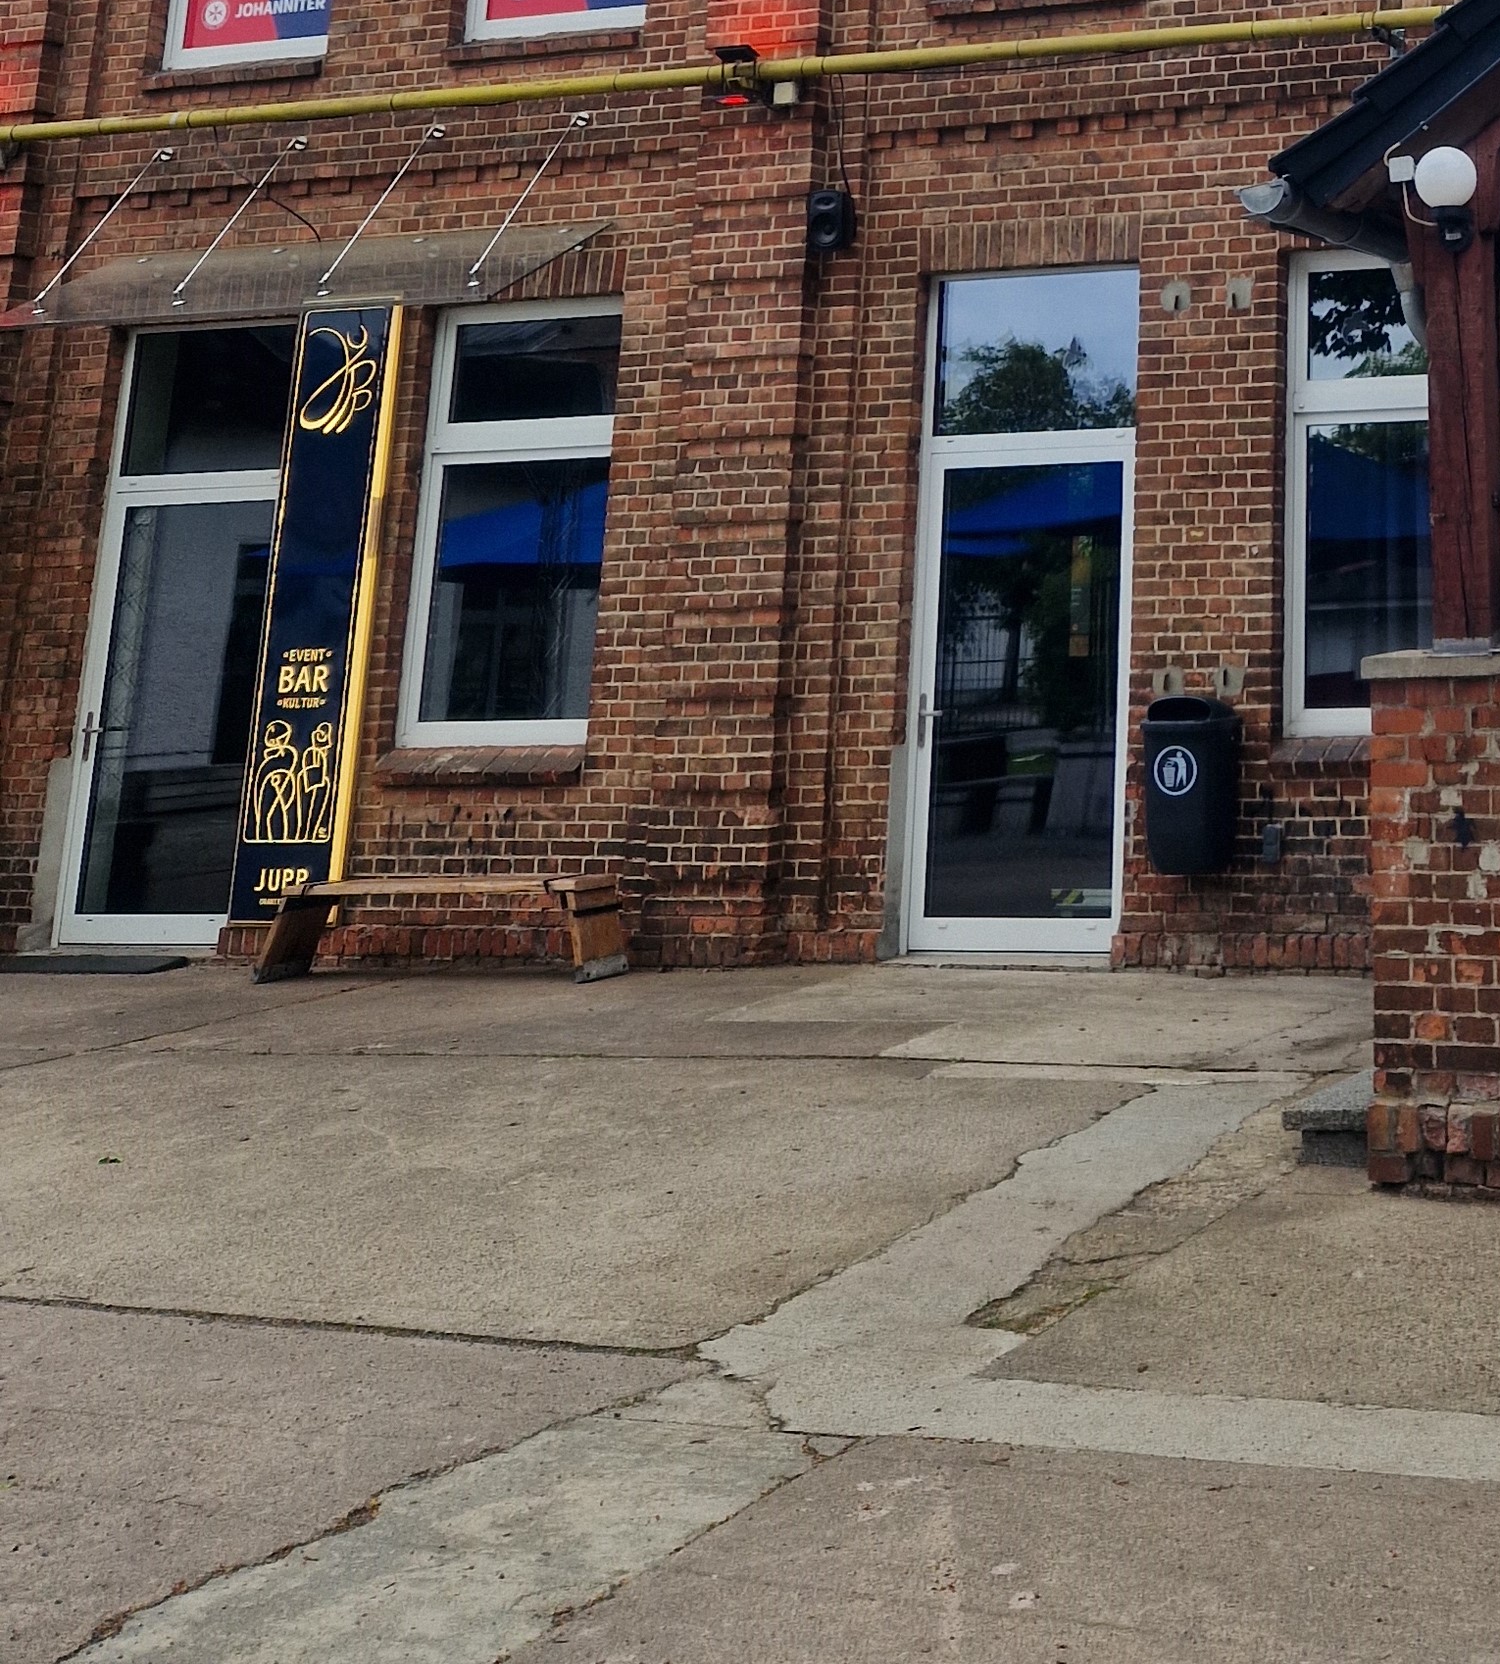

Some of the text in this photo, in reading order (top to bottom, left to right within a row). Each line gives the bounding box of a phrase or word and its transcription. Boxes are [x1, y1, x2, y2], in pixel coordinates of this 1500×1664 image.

[288, 648, 327, 662] EVENT
[277, 665, 329, 694] BAR
[281, 697, 320, 709] KULTUR
[253, 868, 310, 892] JUPP
